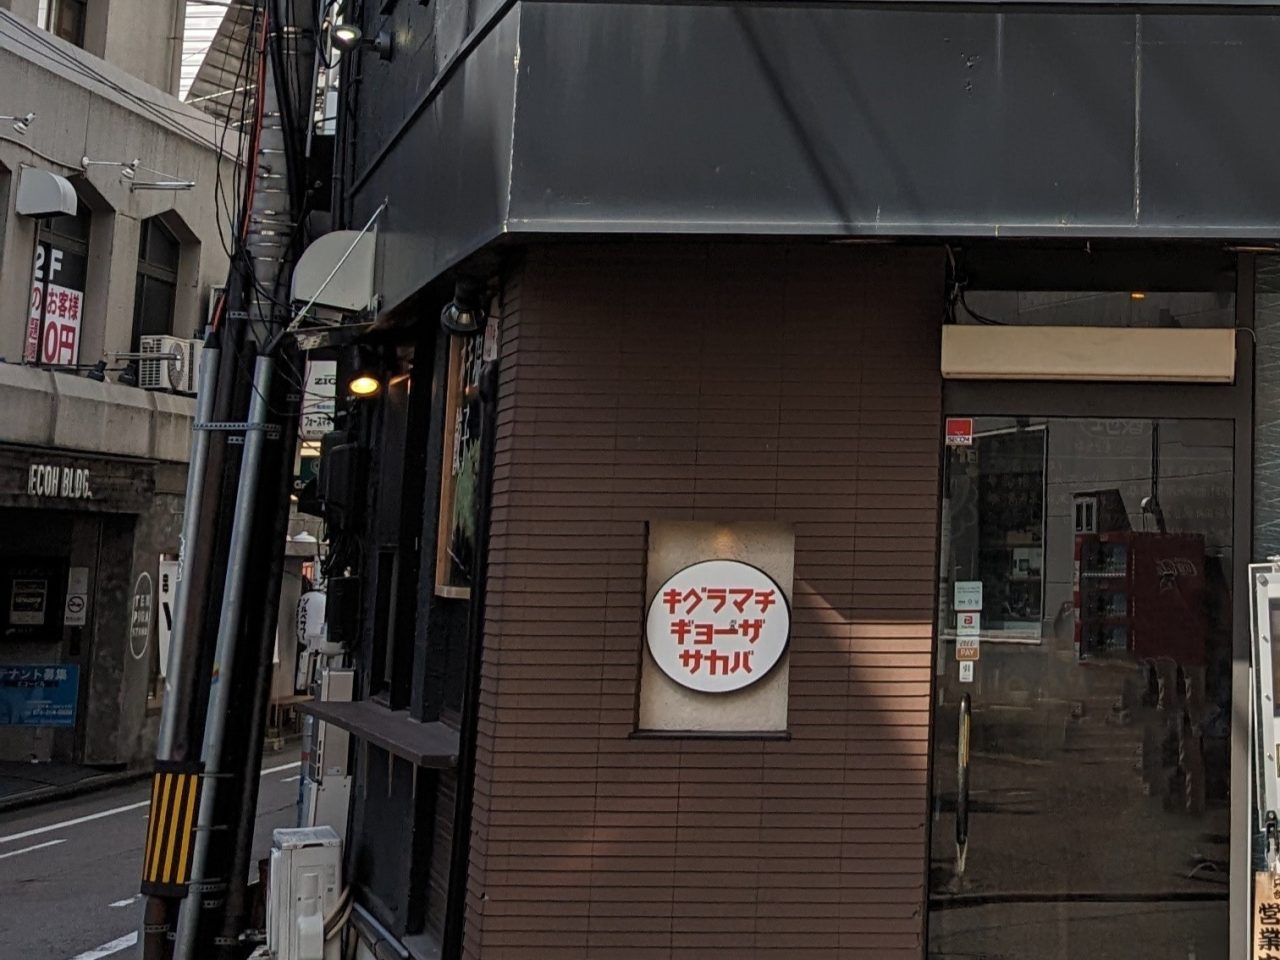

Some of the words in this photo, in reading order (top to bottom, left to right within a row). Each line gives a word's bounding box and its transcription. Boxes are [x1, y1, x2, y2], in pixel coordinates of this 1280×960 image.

[663, 587, 776, 616] キグラマチ
[670, 619, 766, 646] ギョーザ
[678, 650, 755, 676] サカバ
[960, 648, 974, 657] PAY
